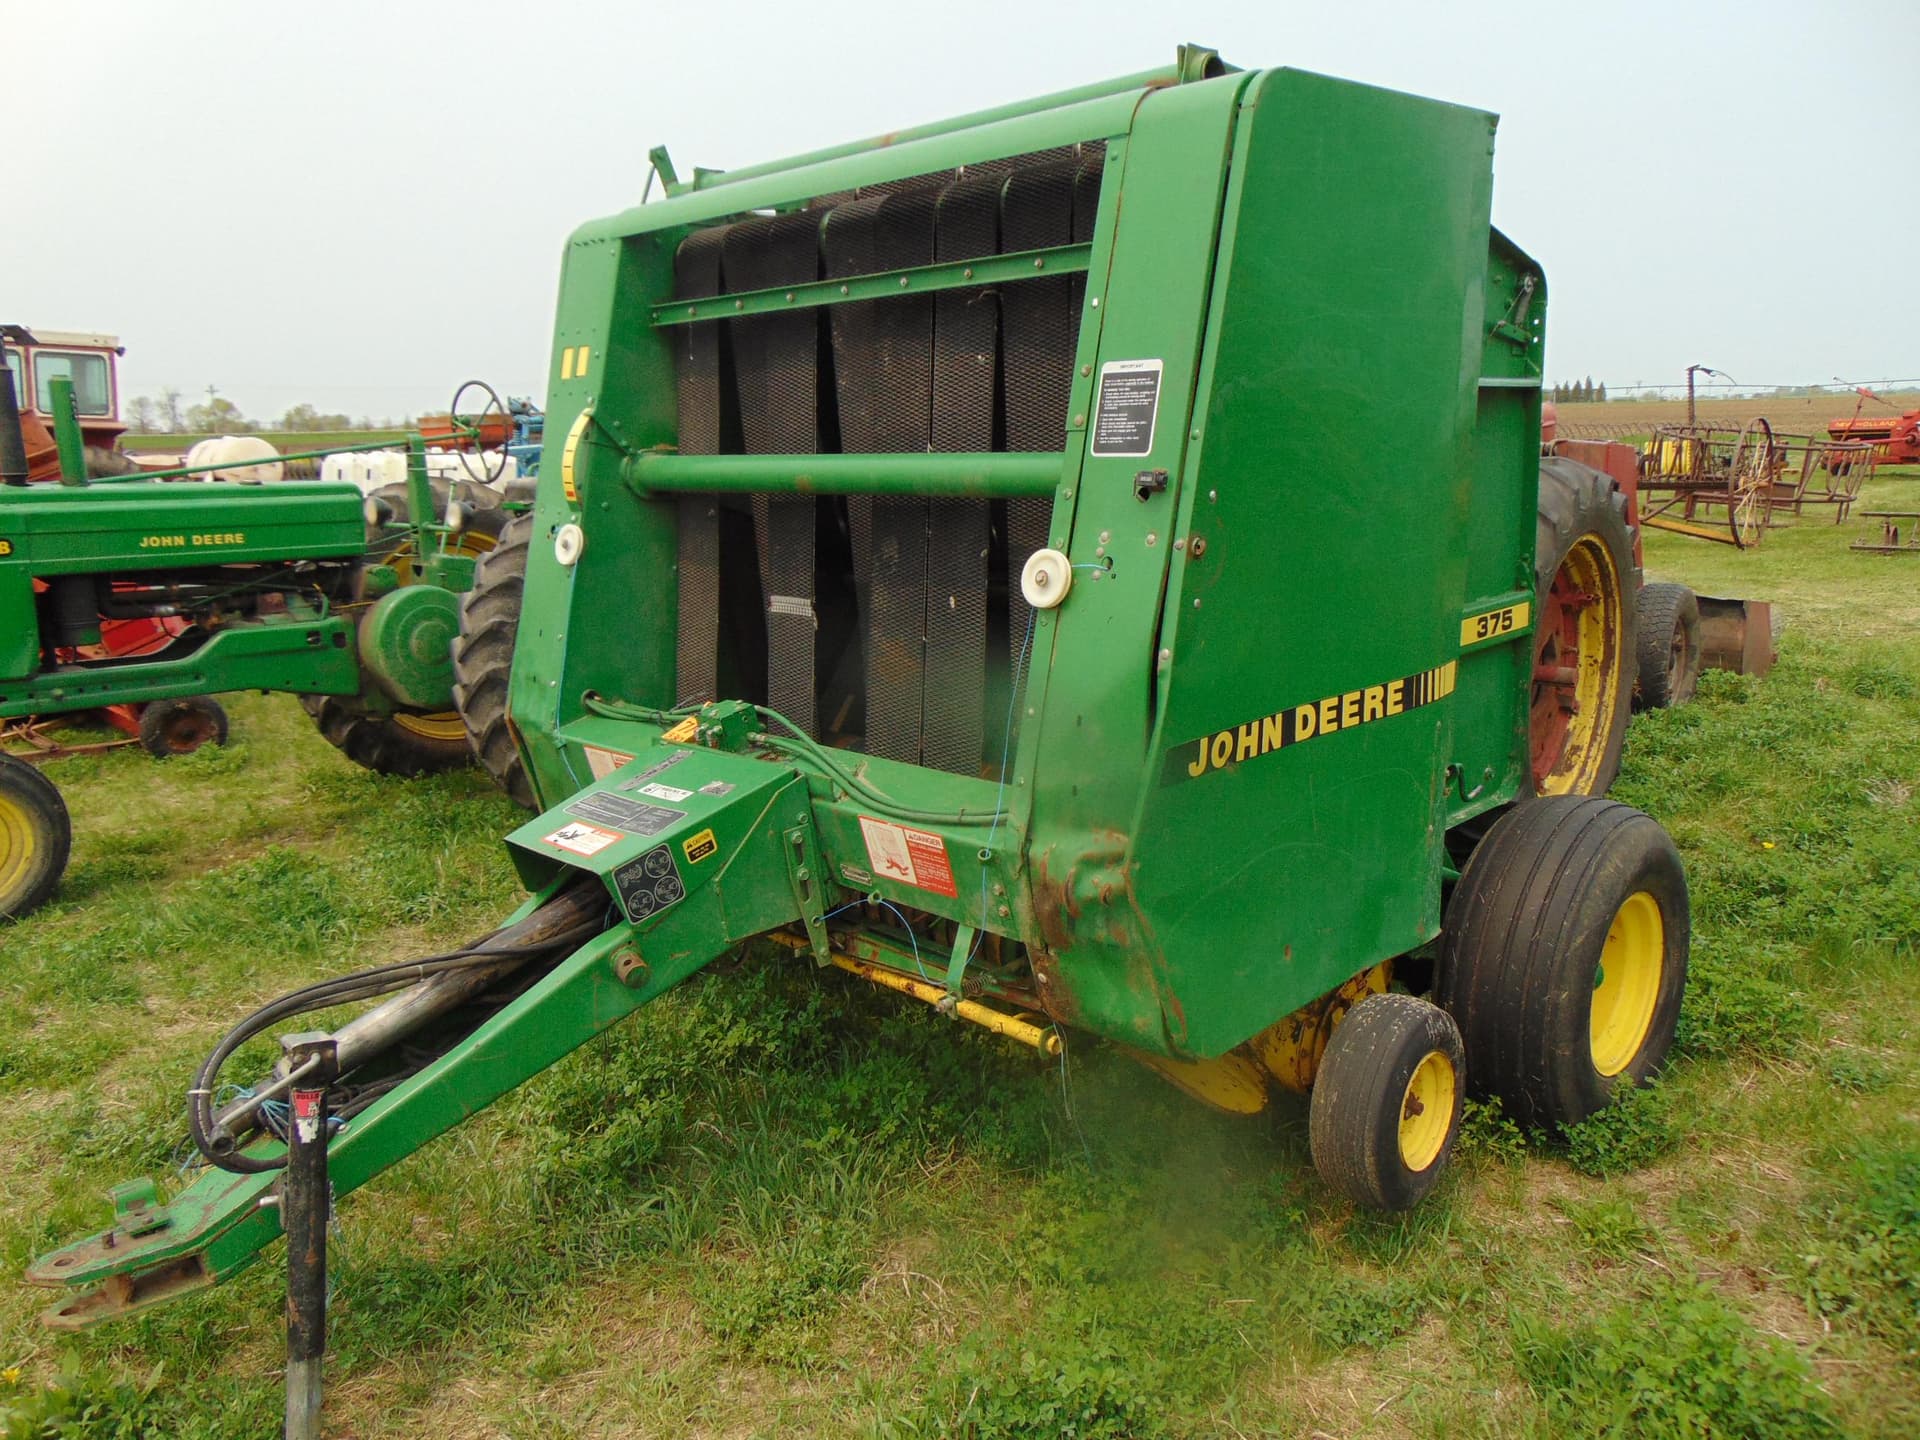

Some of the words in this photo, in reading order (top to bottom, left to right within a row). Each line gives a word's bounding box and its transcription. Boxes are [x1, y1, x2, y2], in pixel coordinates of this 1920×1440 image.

[139, 535, 185, 547] JOHN
[192, 533, 244, 545] DEERE
[1477, 609, 1513, 638] 375
[1188, 712, 1282, 777] JOHN
[1294, 679, 1404, 742] DEERE
